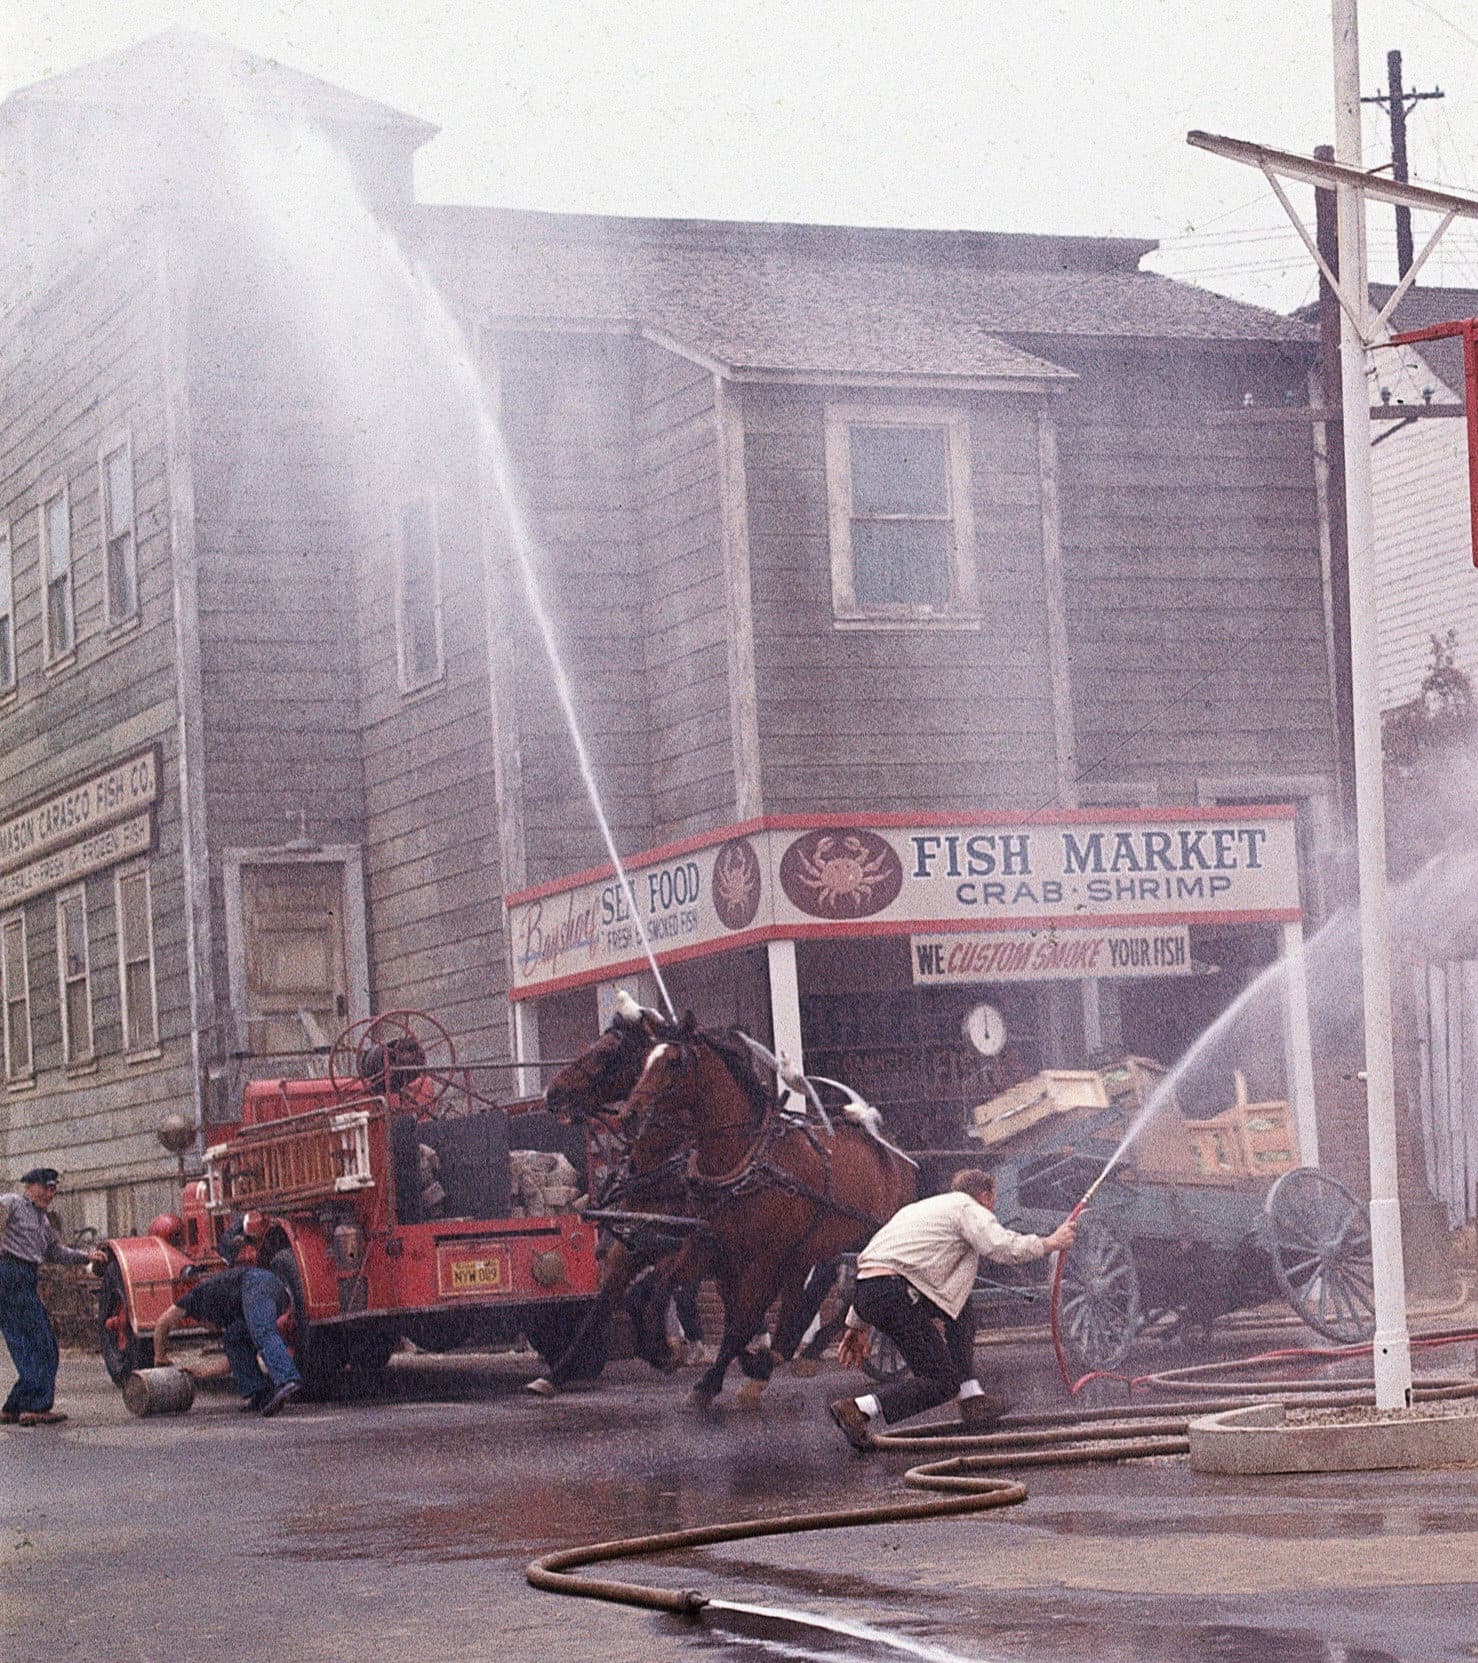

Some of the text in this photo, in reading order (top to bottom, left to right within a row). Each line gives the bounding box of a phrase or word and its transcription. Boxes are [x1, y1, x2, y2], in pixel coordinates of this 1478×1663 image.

[96, 770, 124, 815] FISH
[131, 760, 155, 798] CO.
[912, 828, 1266, 878] FISH MARKET
[648, 862, 700, 914] FOOD
[956, 875, 1231, 905] CRAB SHRIMP
[607, 927, 633, 954] FRESH
[648, 914, 679, 944] SMOKED
[681, 908, 698, 936] FISH
[917, 936, 1187, 975] WE CUSTOM SMOKE YOUR FISH
